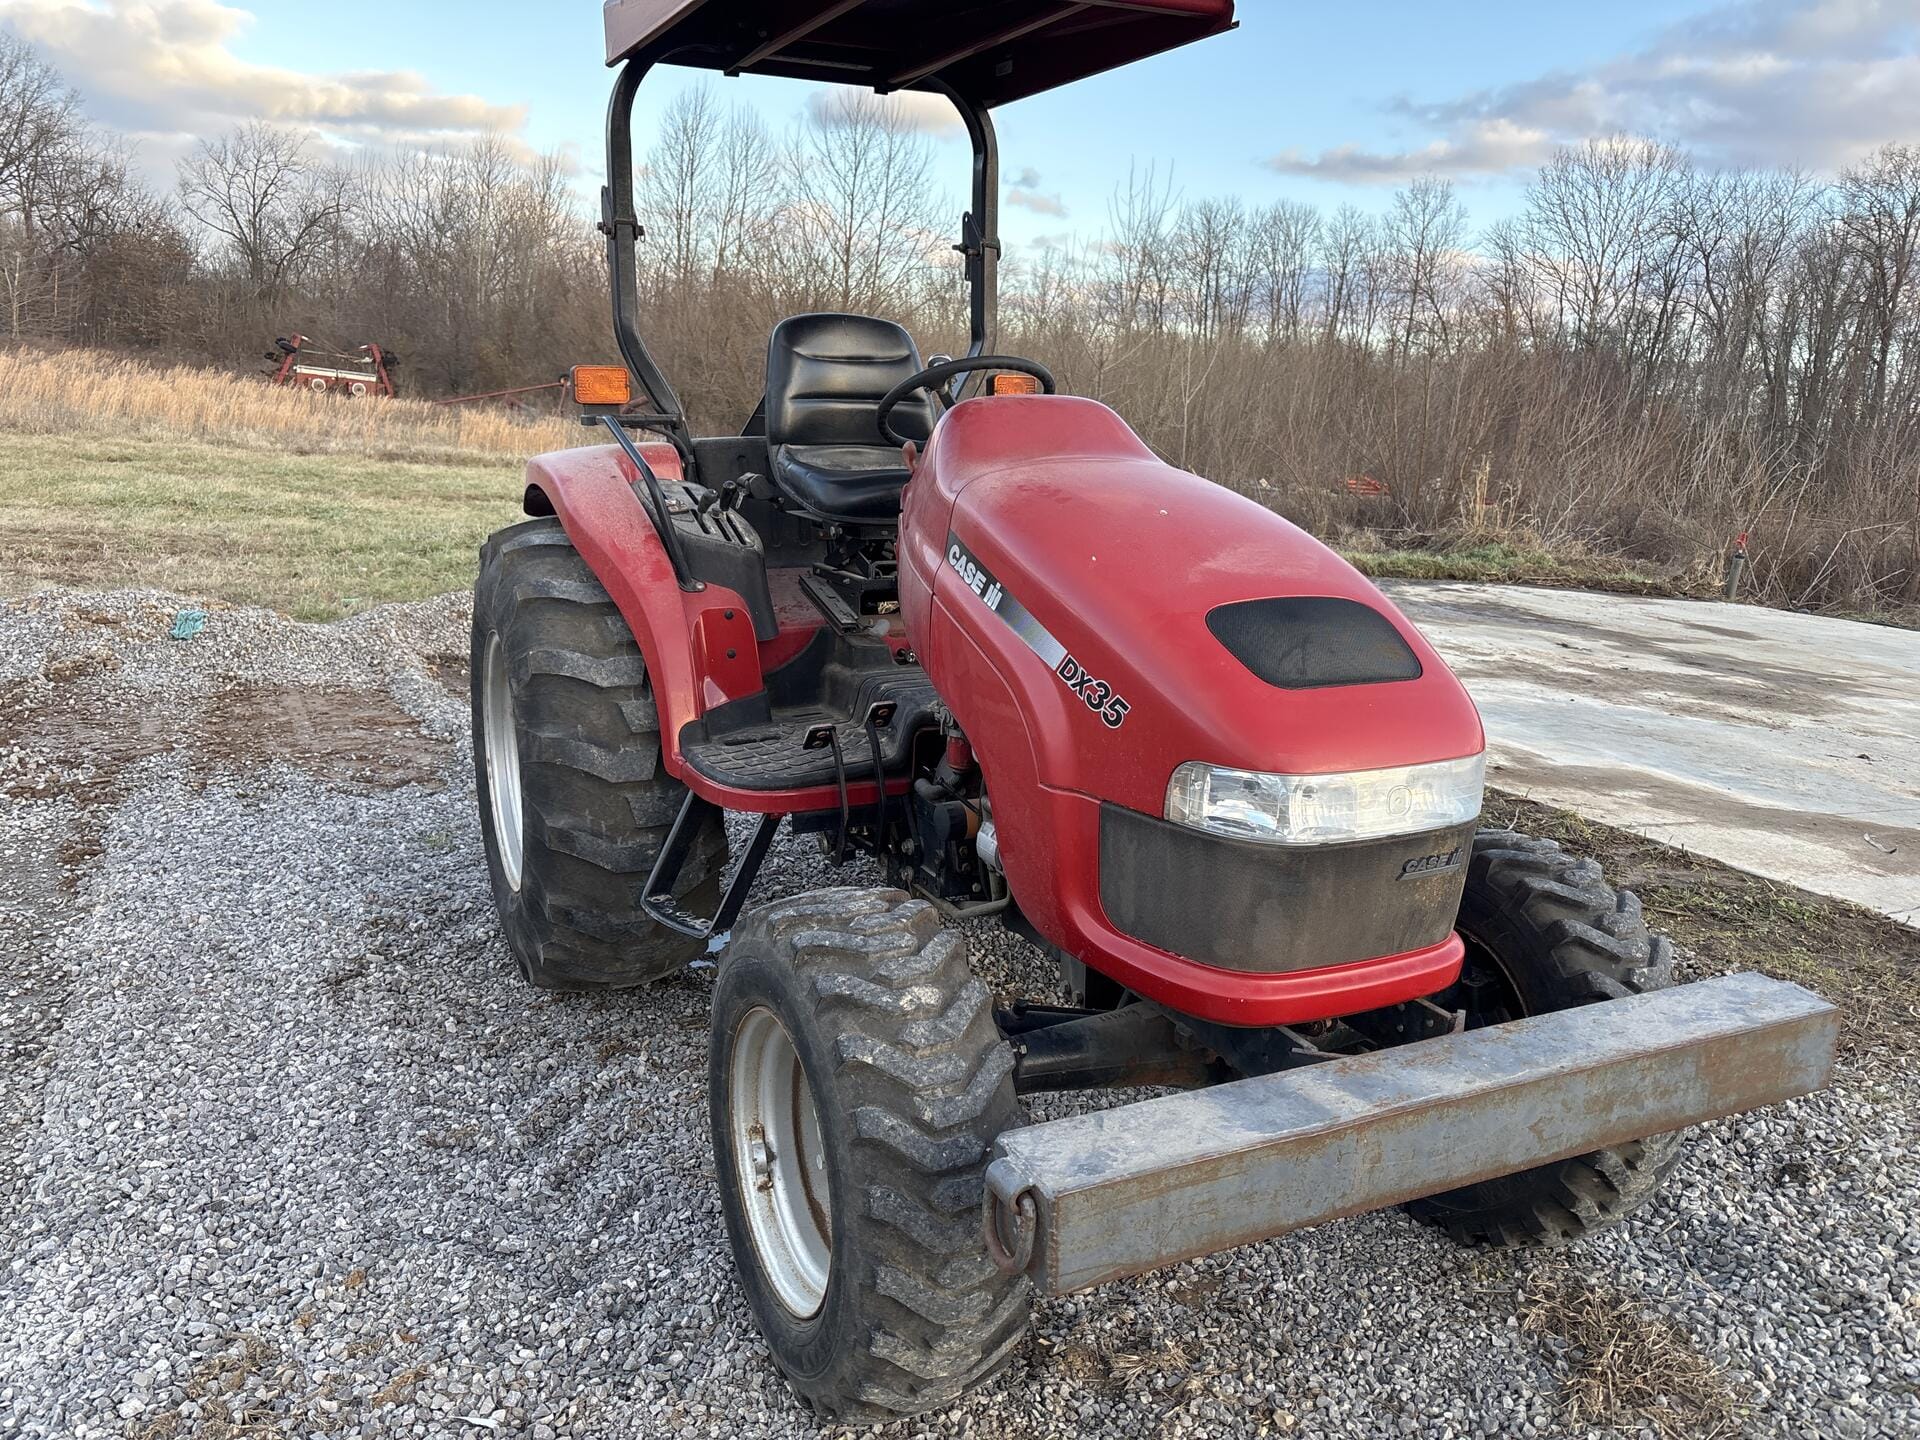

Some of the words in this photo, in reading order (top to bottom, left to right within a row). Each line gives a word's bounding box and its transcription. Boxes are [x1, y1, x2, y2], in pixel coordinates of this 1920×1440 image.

[949, 544, 986, 594] CASE
[1057, 654, 1131, 728] DX35
[1404, 855, 1449, 873] CASE
